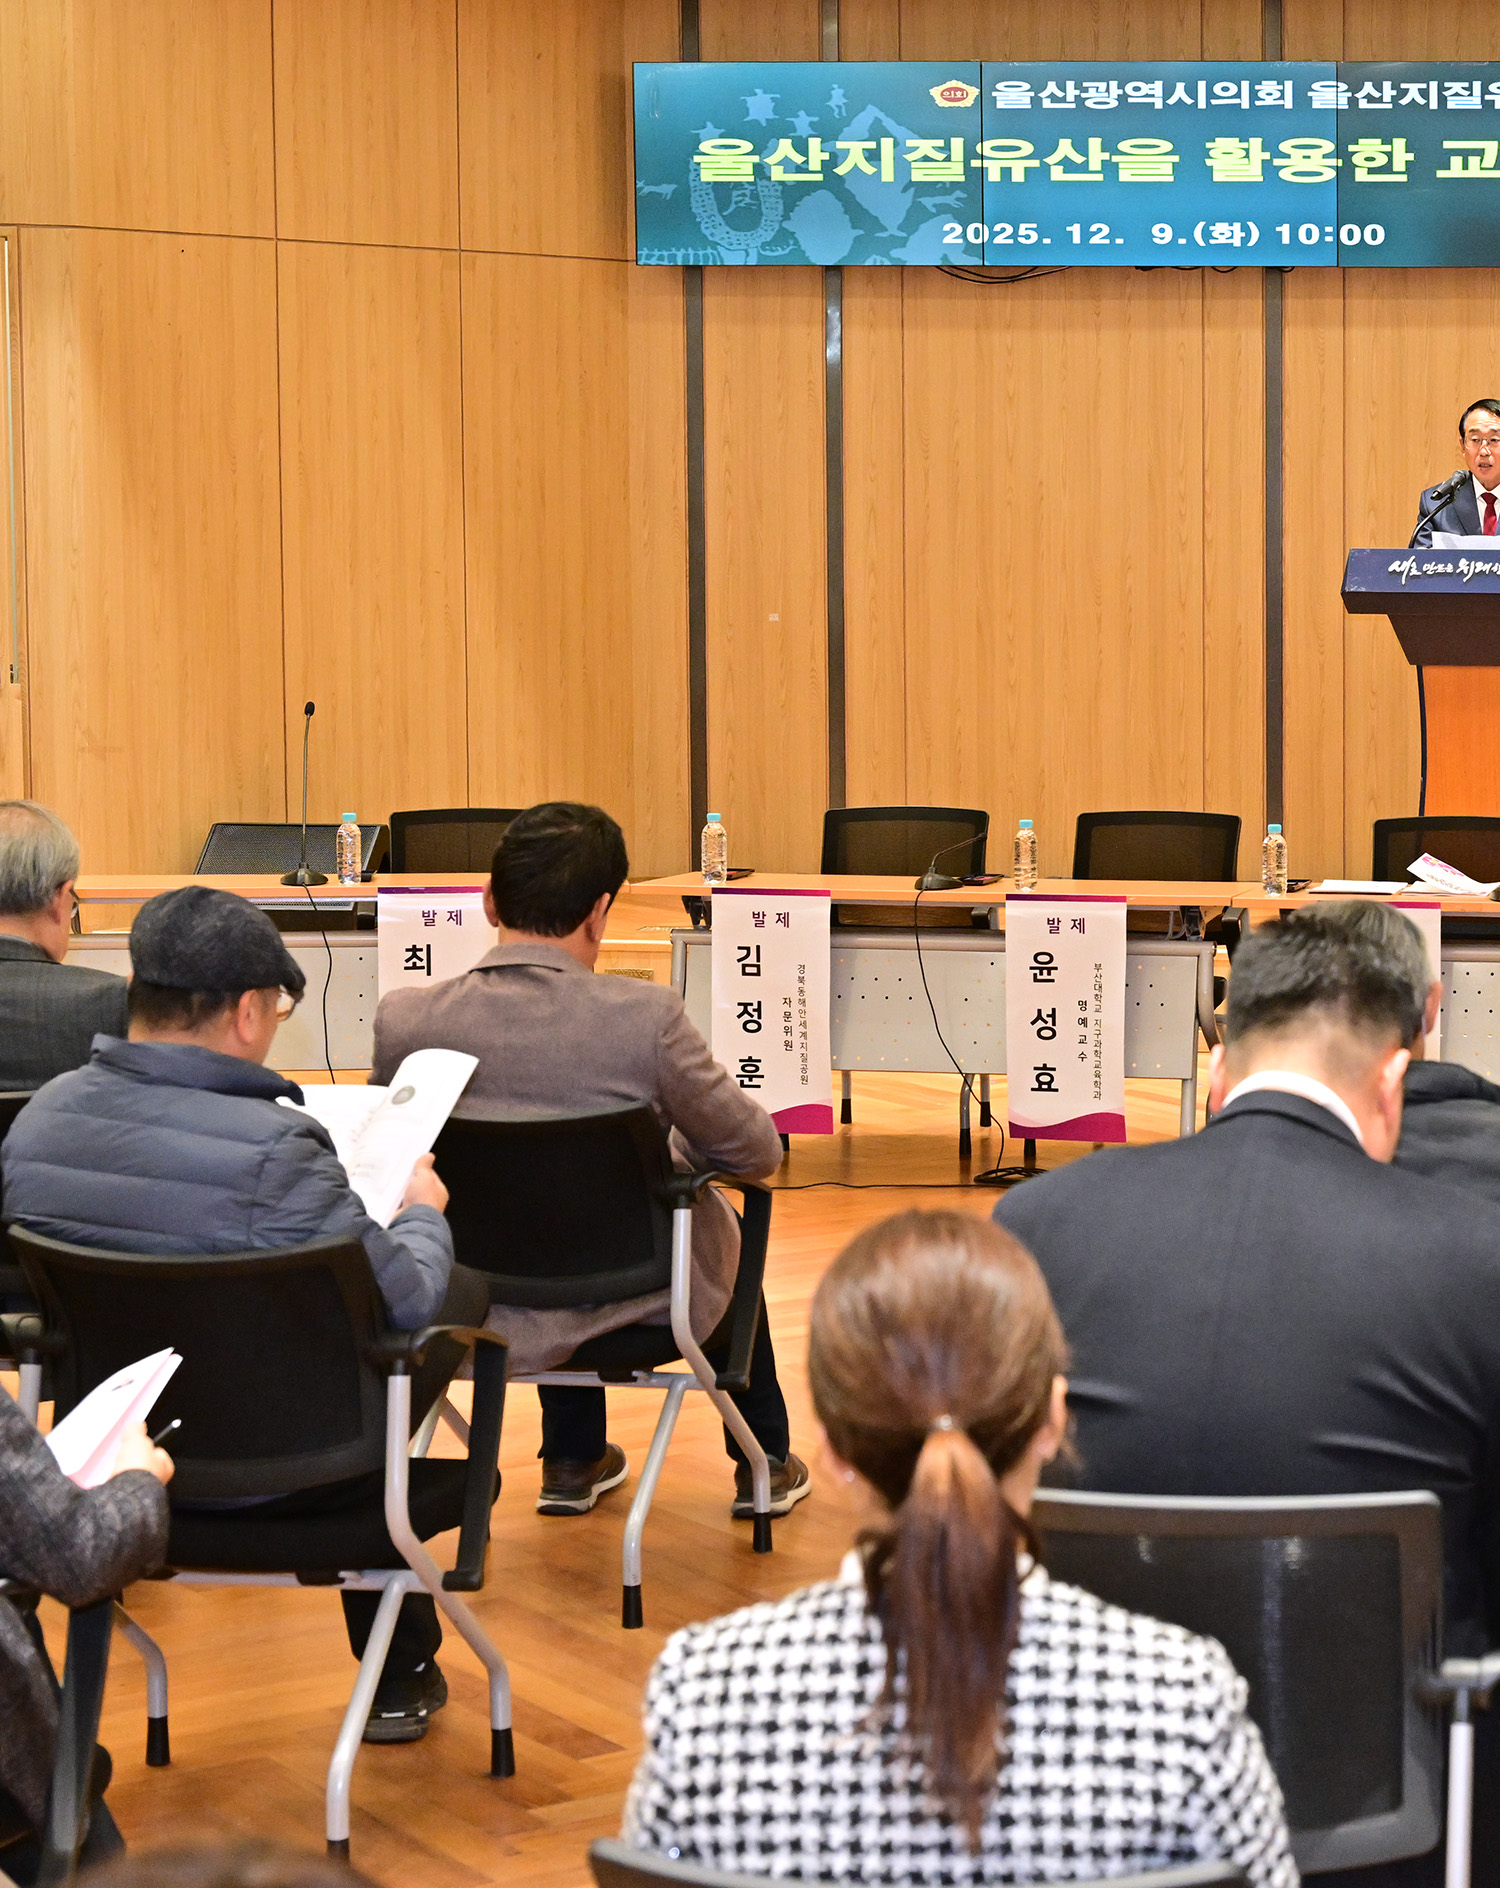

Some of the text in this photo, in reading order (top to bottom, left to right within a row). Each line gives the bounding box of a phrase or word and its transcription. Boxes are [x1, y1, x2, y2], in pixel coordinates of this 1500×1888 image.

[991, 79, 1293, 110] 울산광역시의회
[692, 137, 1180, 183] 울산지질유산을
[1204, 137, 1416, 183] 활용한
[942, 221, 1386, 248] 2025. 12. 9.(화) 10:00
[1388, 555, 1422, 585] 새로
[735, 944, 765, 1089] 김정훈
[782, 996, 794, 1052] 자문위원
[1029, 951, 1059, 1093] 윤성효
[1077, 999, 1089, 1063] 명예교수
